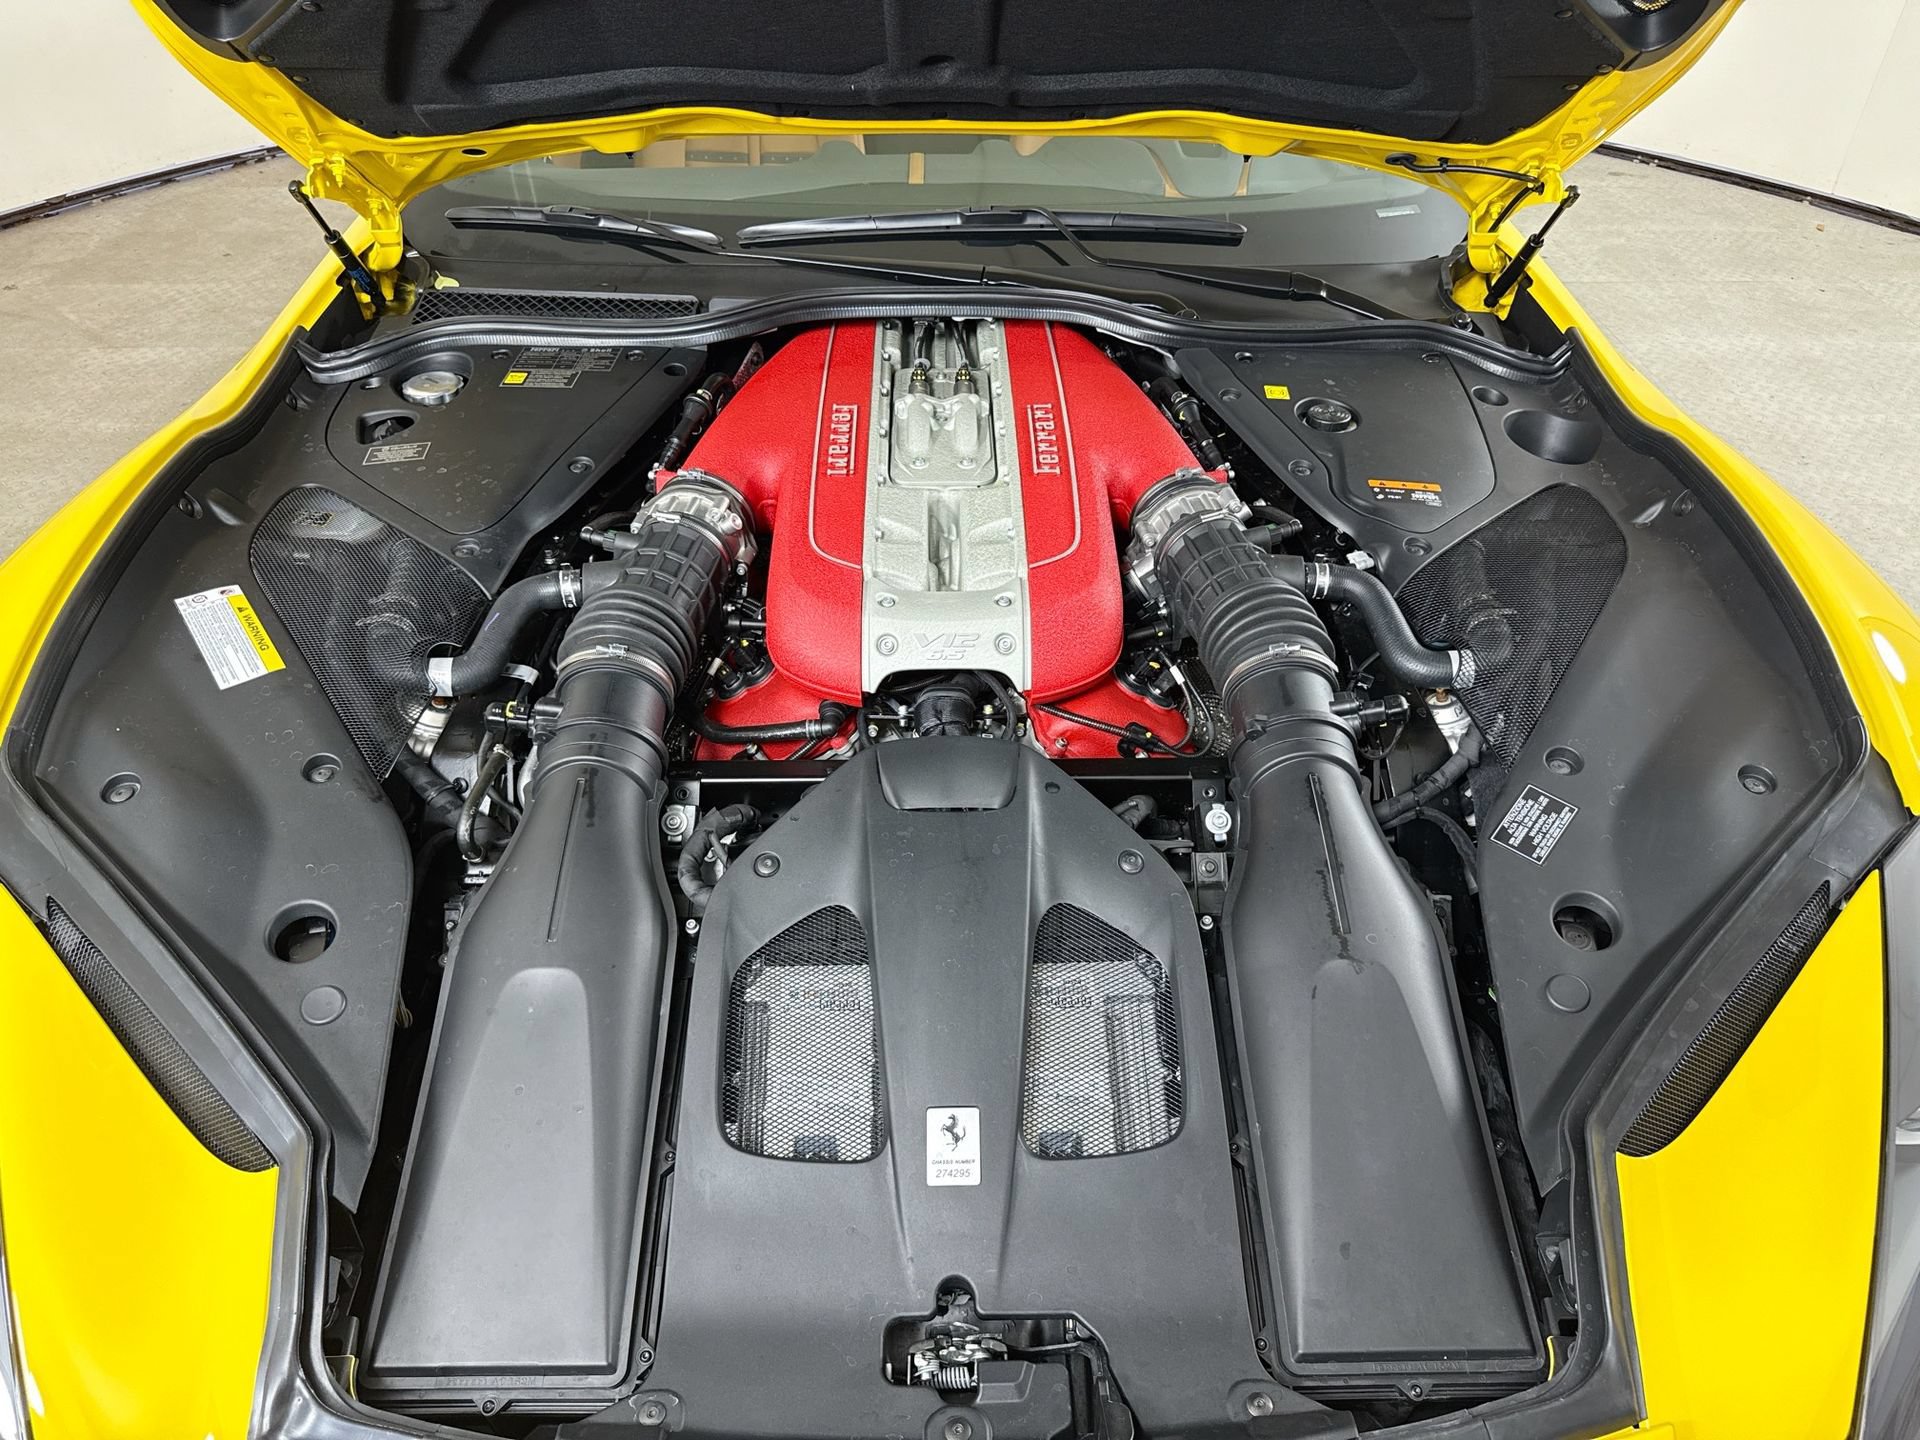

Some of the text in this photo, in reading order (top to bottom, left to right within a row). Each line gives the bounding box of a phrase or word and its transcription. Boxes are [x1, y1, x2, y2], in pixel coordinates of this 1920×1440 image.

[827, 403, 858, 477] Ferrari
[1027, 403, 1061, 476] Ferrari
[243, 613, 270, 651] WARNING
[913, 633, 980, 648] V12
[935, 1168, 971, 1178] 274295
